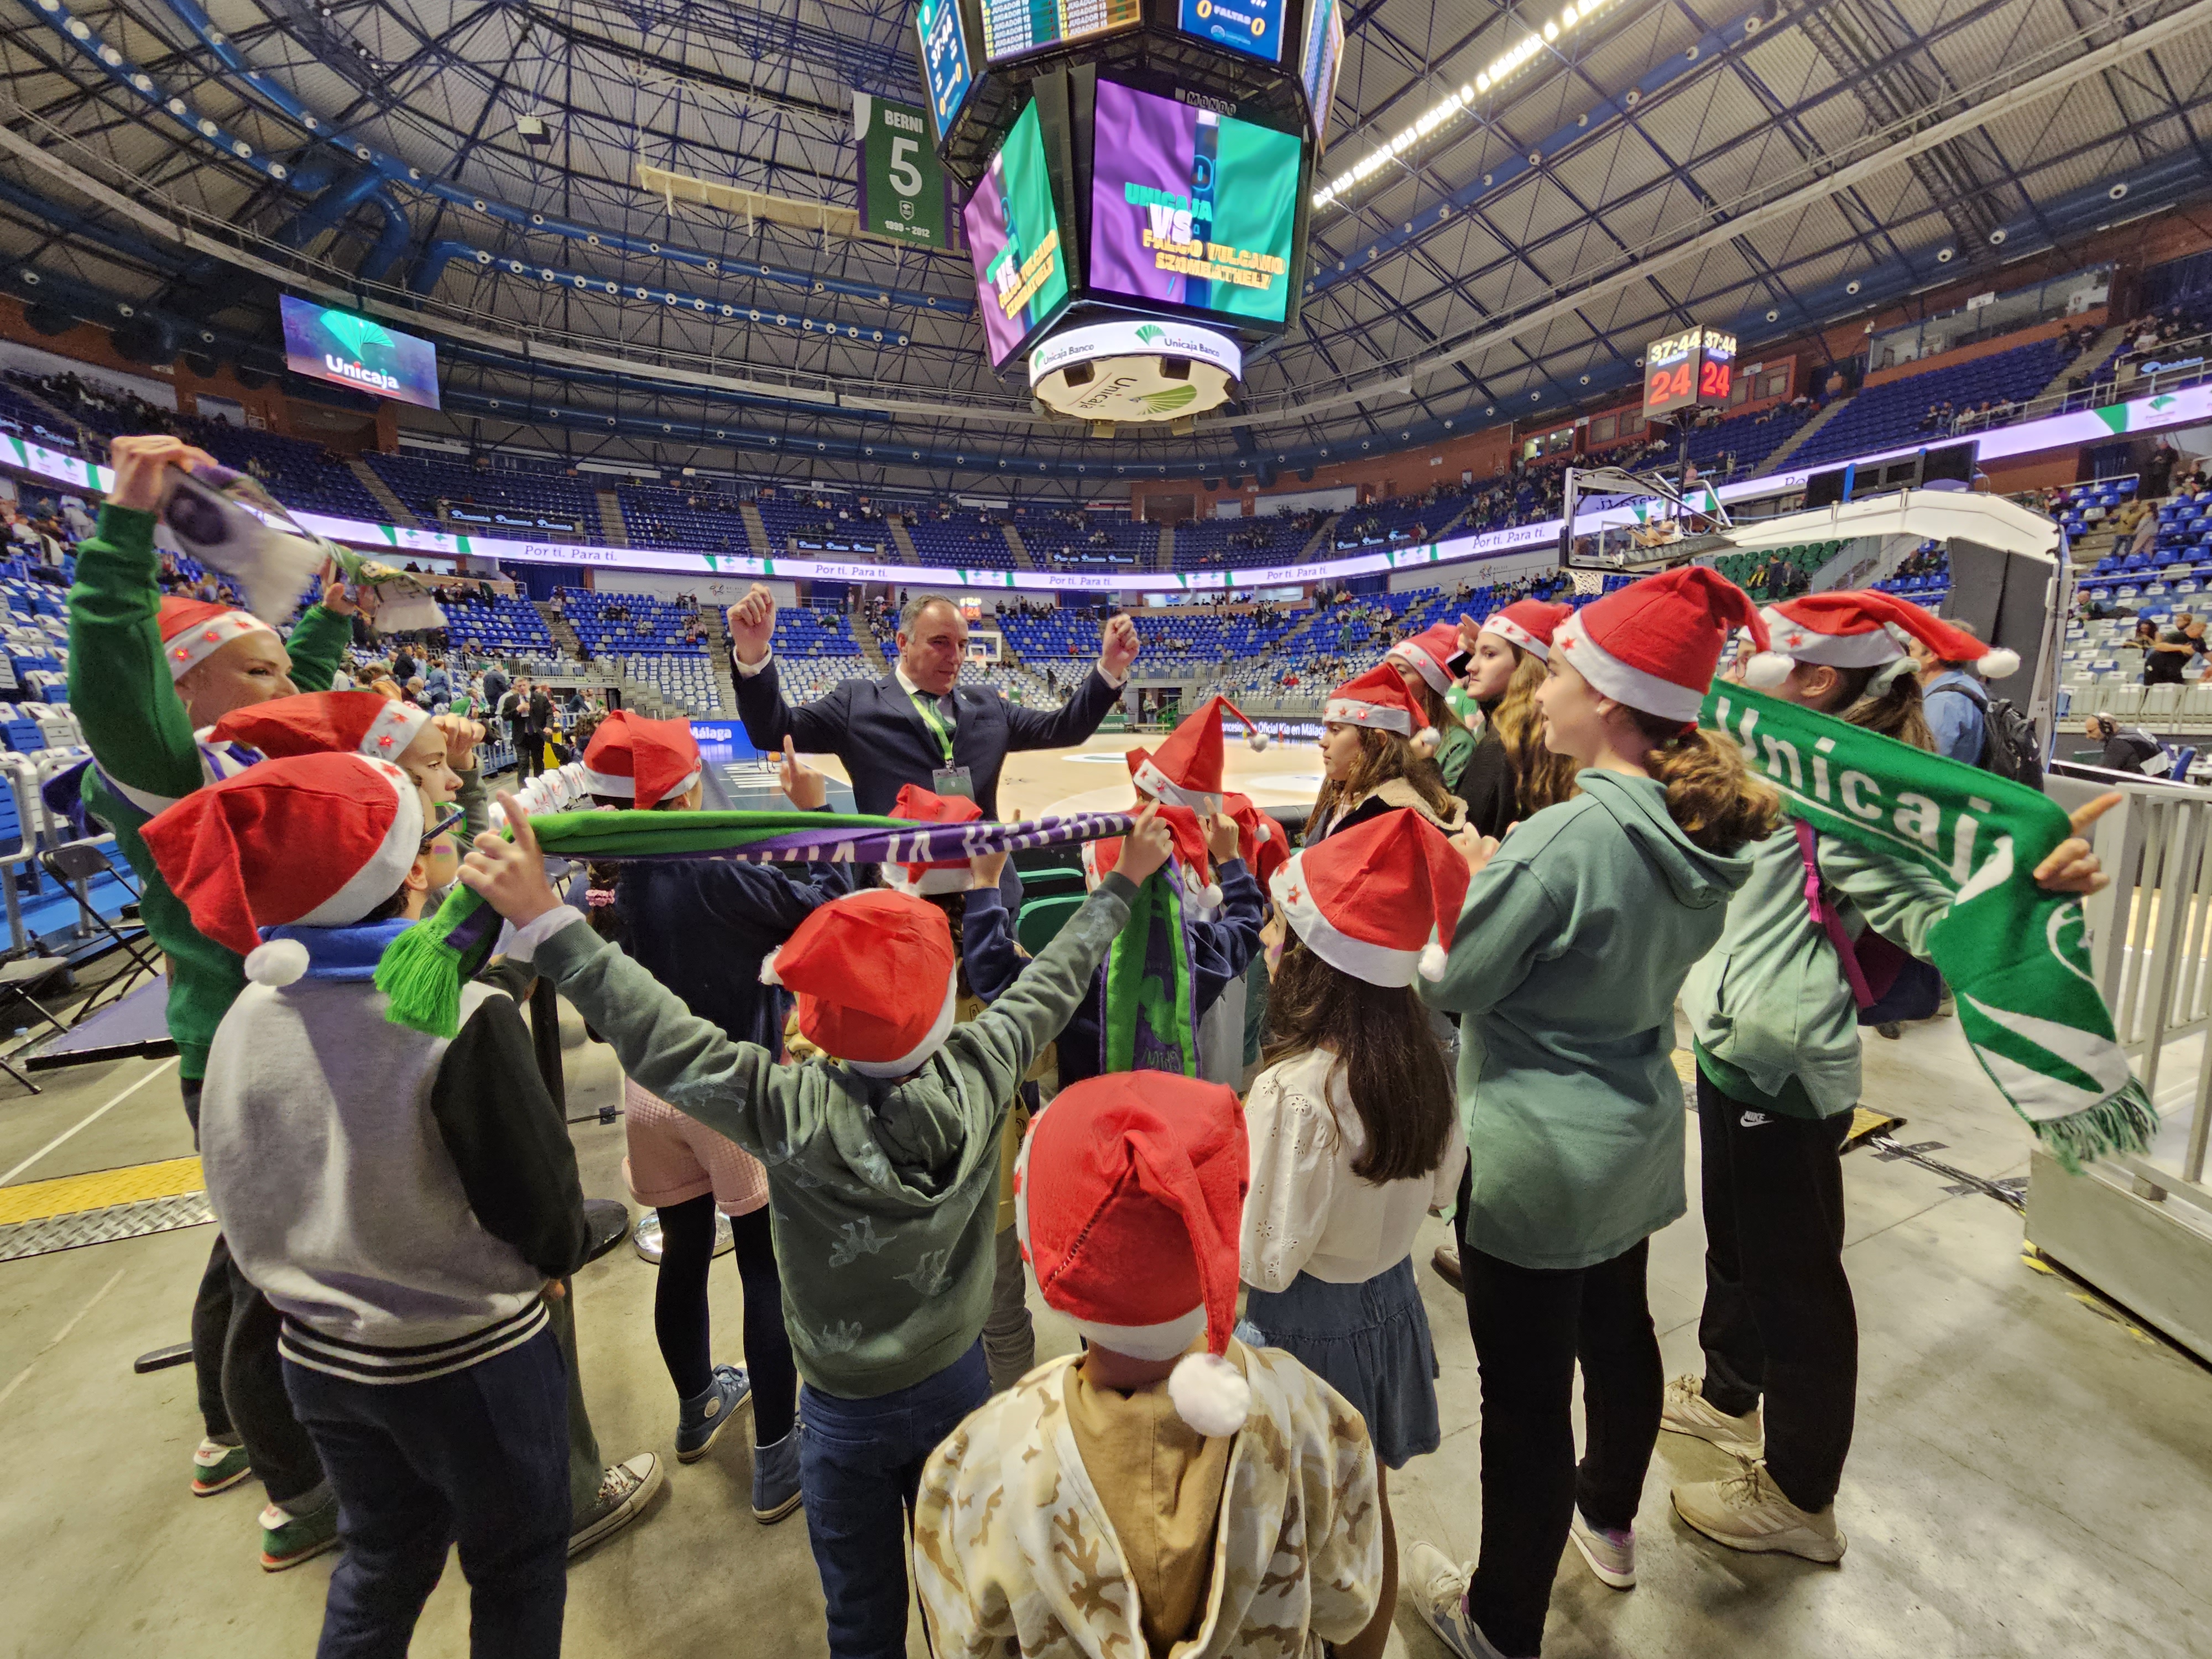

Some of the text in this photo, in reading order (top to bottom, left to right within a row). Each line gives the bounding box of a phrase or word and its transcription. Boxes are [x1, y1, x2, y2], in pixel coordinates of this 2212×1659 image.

[992, 8, 1022, 23] JUGADOR
[1068, 4, 1098, 19] JUGADOR
[1197, 0, 1266, 36] 0 FALTAS 0
[993, 16, 1022, 32] JUGADOR
[1068, 13, 1098, 28] JUGADOR
[994, 25, 1024, 40] JUGADOR
[1070, 22, 1099, 36] JUGADOR
[994, 33, 1024, 48] JUGADOR
[995, 42, 1024, 56] JUGADOR
[1187, 91, 1237, 116] MONDO
[885, 109, 923, 133] BERNI
[889, 136, 922, 196] 5
[1150, 202, 1192, 245] VS
[911, 226, 930, 238] 2012
[1165, 338, 1220, 357] Unicaja Banco
[1651, 331, 1701, 362] 37:44
[1704, 331, 1737, 356] 37:44
[1044, 343, 1094, 365] Unicaja Banco
[326, 354, 400, 389] Unicaja
[1702, 361, 1730, 398] 24
[1649, 363, 1692, 405] 24
[1079, 377, 1138, 409] Unicaja
[1473, 538, 1490, 549] Por
[1507, 531, 1531, 543] Para
[525, 545, 548, 556] Por
[571, 551, 601, 561] Para
[816, 565, 834, 574] Por
[852, 567, 875, 576] Para
[1267, 571, 1283, 580] Por
[1297, 568, 1317, 577] Para
[1049, 576, 1066, 585] Por
[1258, 721, 1278, 733] Oficial
[1280, 723, 1290, 735] Kia
[1291, 725, 1300, 735] en
[1744, 1110, 1765, 1123] NIKE
